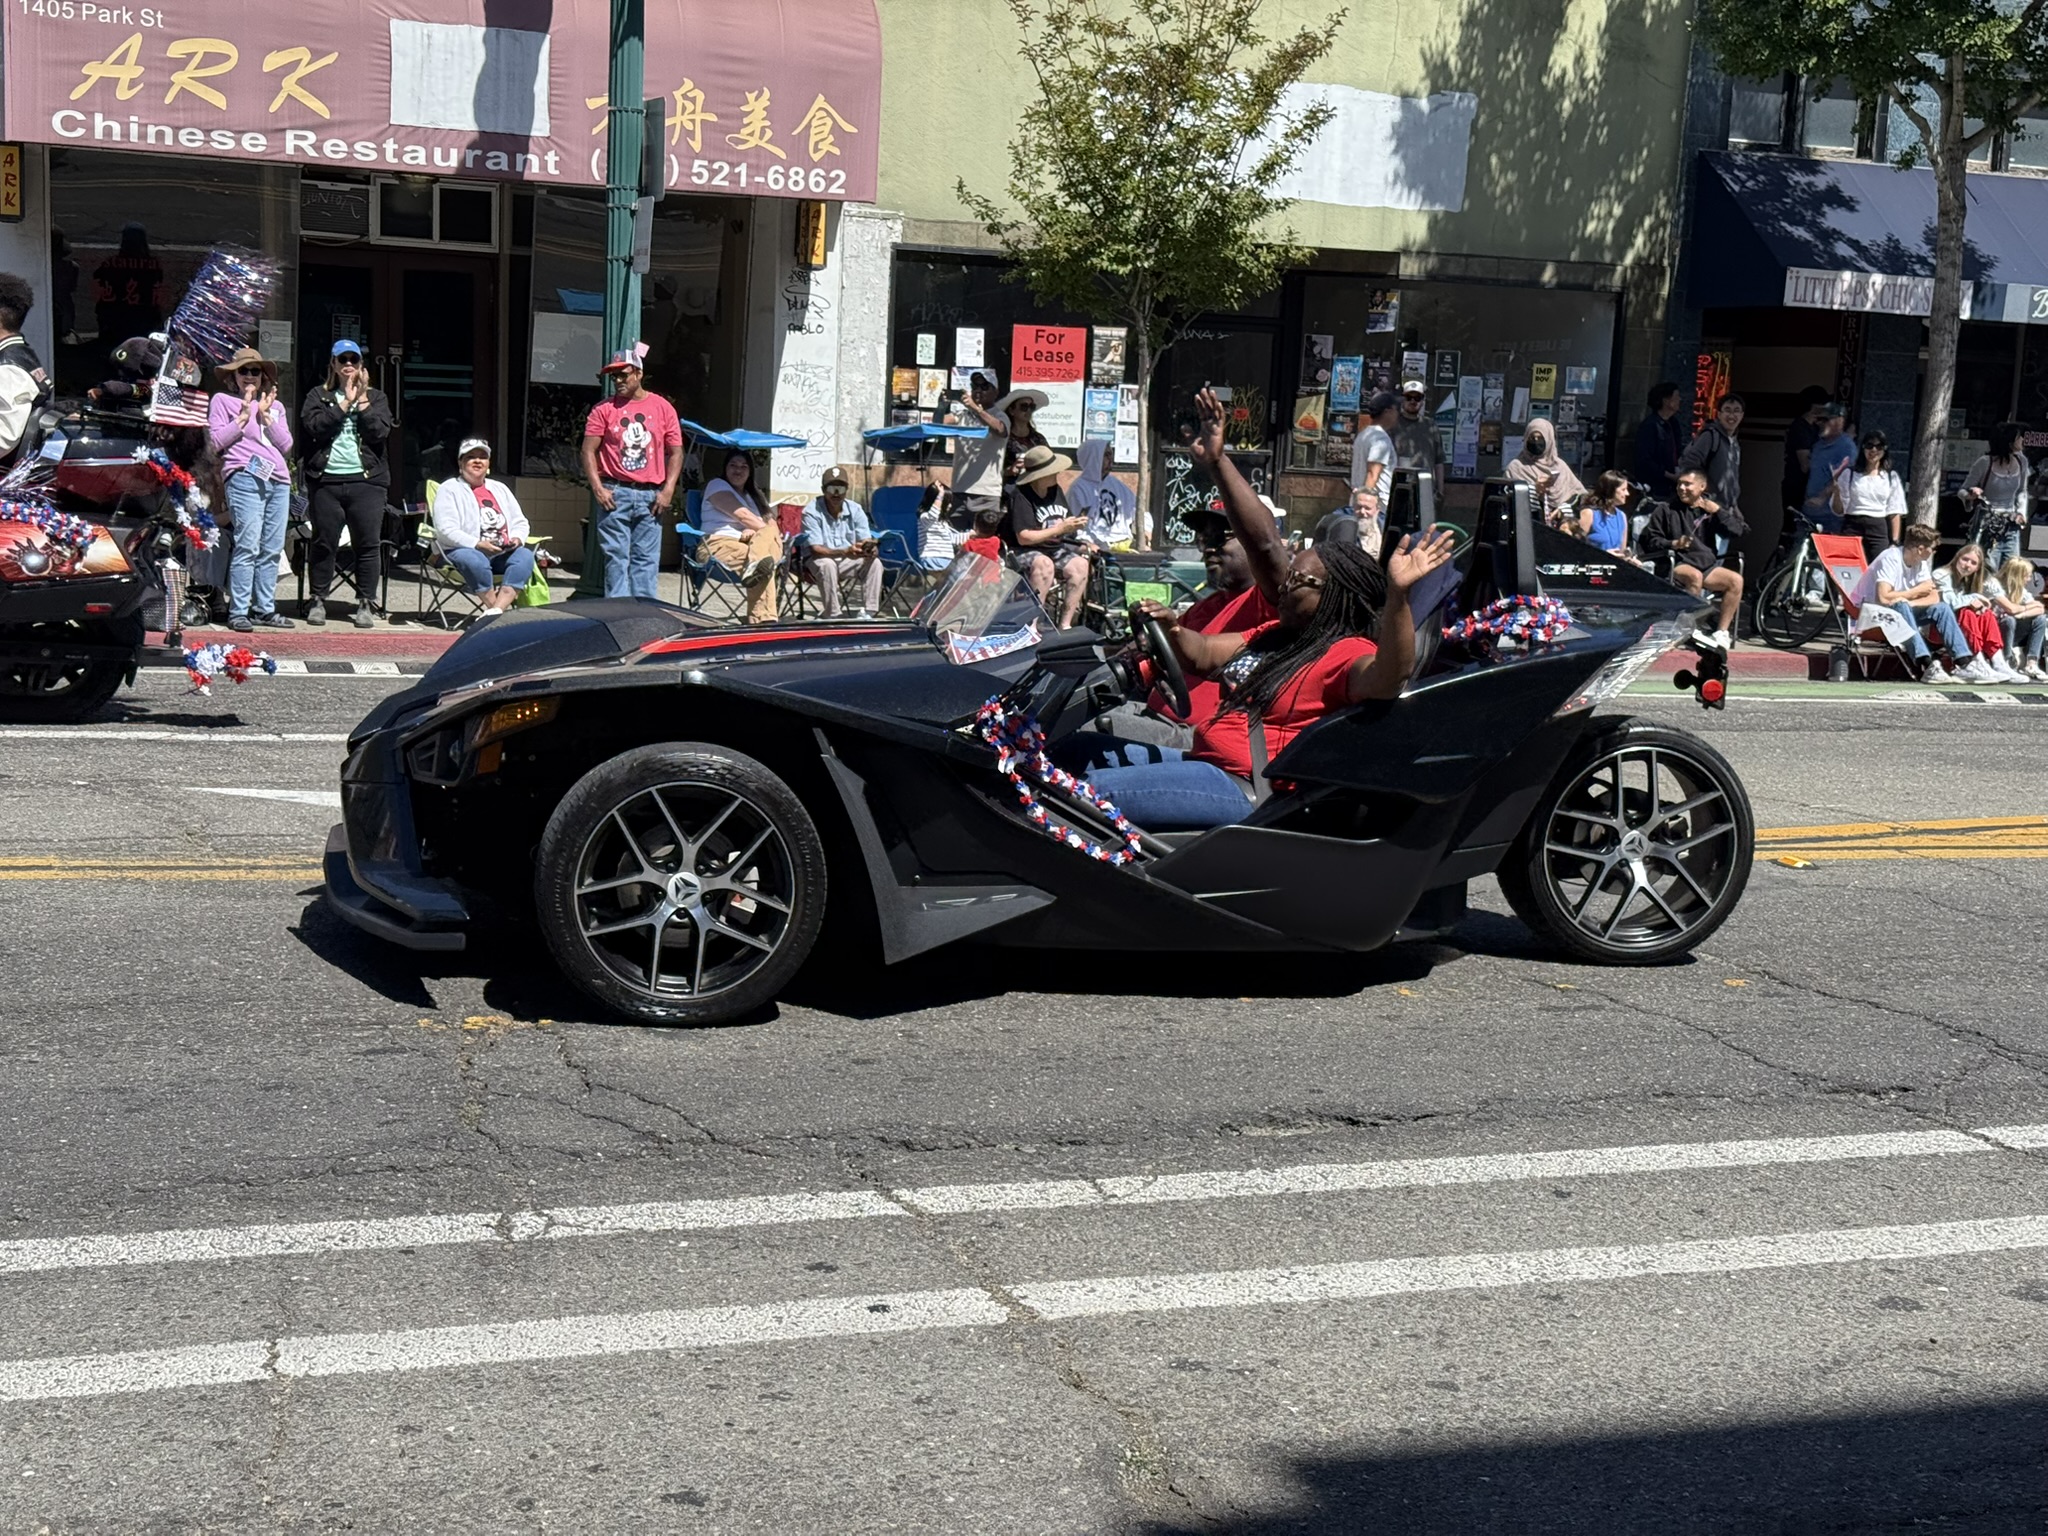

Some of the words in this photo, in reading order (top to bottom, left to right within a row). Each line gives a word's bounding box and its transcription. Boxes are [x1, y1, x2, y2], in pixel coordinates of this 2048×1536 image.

[19, 0, 75, 20] 1405
[82, 3, 134, 26] Park
[140, 8, 164, 28] St
[69, 32, 339, 120] ARK
[51, 109, 267, 153] Chinese
[285, 129, 561, 176] Restaurant
[3, 152, 17, 207] ARK
[690, 159, 847, 195] 521-6862
[1792, 275, 1848, 307] LITTLE
[1851, 279, 1919, 312] PSYCHIC
[1034, 329, 1066, 345] For
[1023, 346, 1075, 364] Lease
[1016, 366, 1081, 379] 415.395.7262
[1535, 367, 1553, 376] IMP
